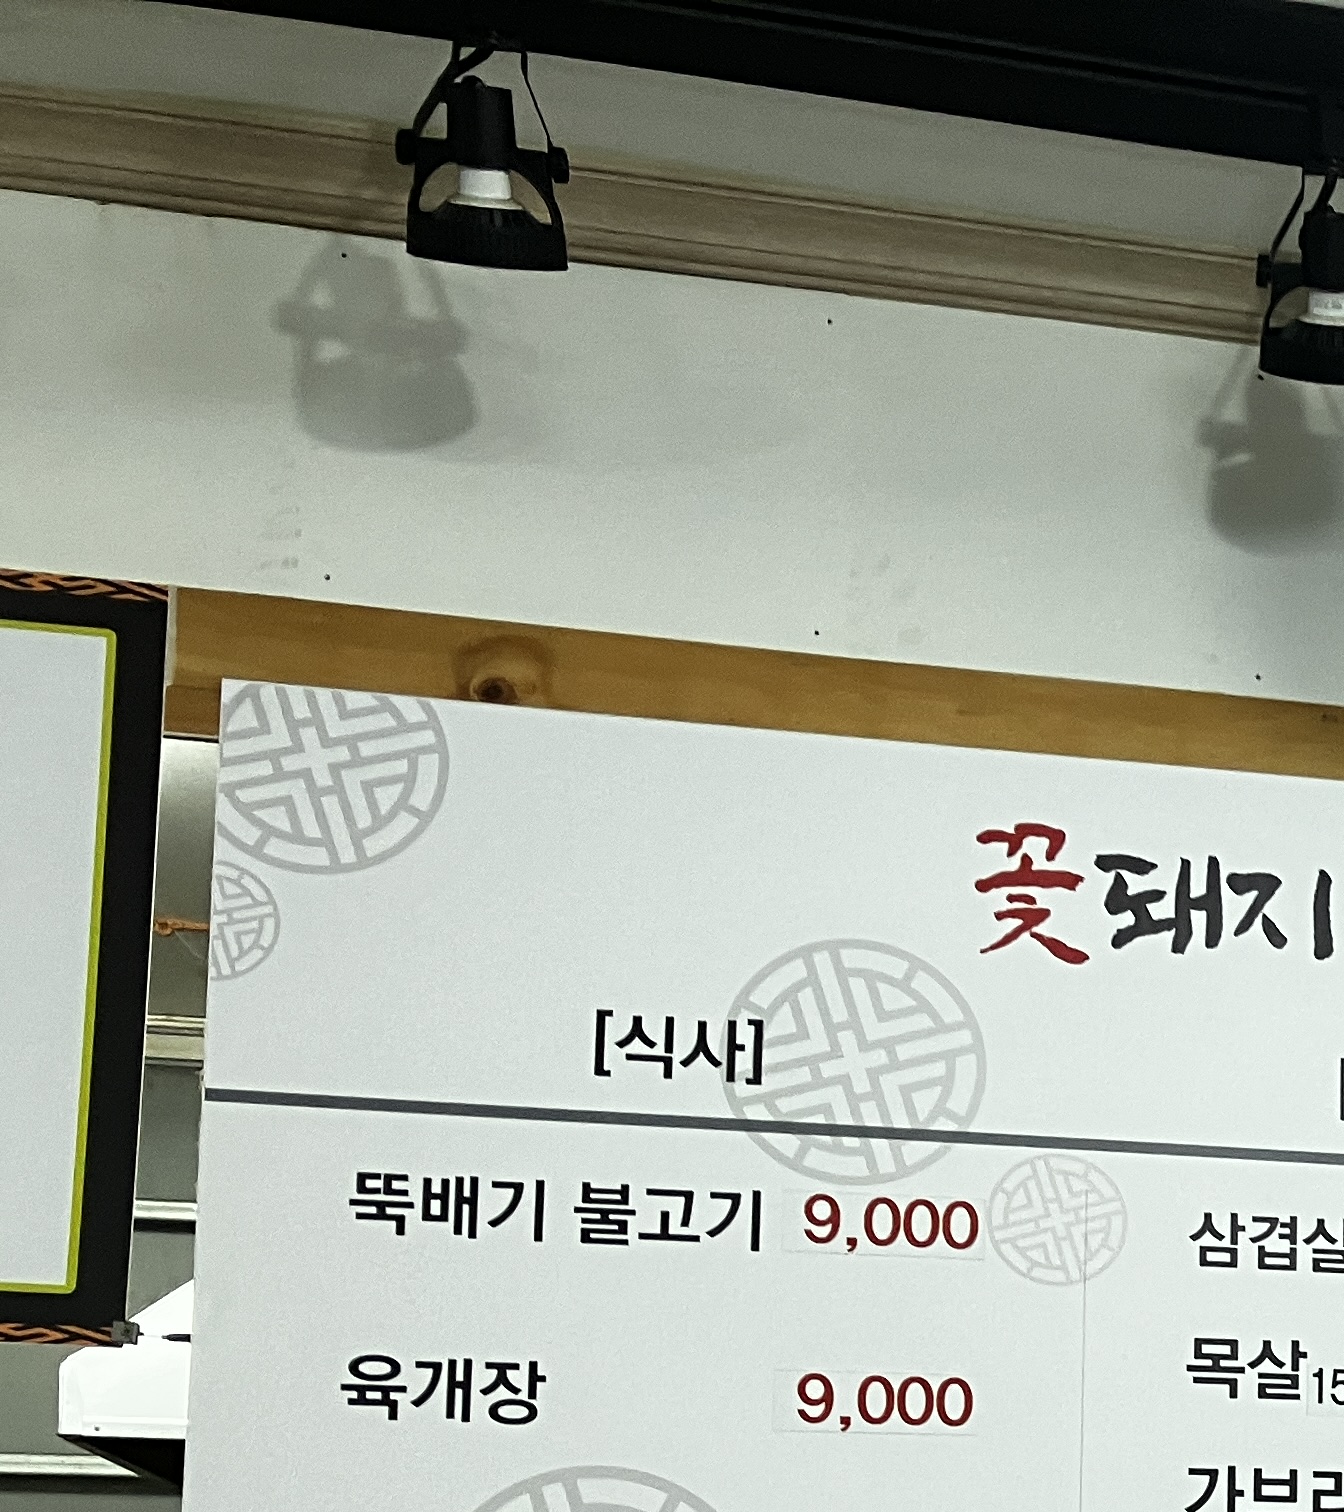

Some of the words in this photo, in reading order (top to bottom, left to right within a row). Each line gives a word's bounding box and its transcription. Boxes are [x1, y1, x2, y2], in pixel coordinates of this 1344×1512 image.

[974, 822, 1334, 965] 꽃돼지
[593, 1008, 765, 1086] [식사]
[348, 1171, 546, 1243] 뚝배기
[573, 1181, 762, 1252] 불고기
[803, 1193, 979, 1253] 9,000
[340, 1354, 547, 1426] 육개장
[797, 1372, 974, 1432] 9,000
[1186, 1337, 1308, 1401] 목살
